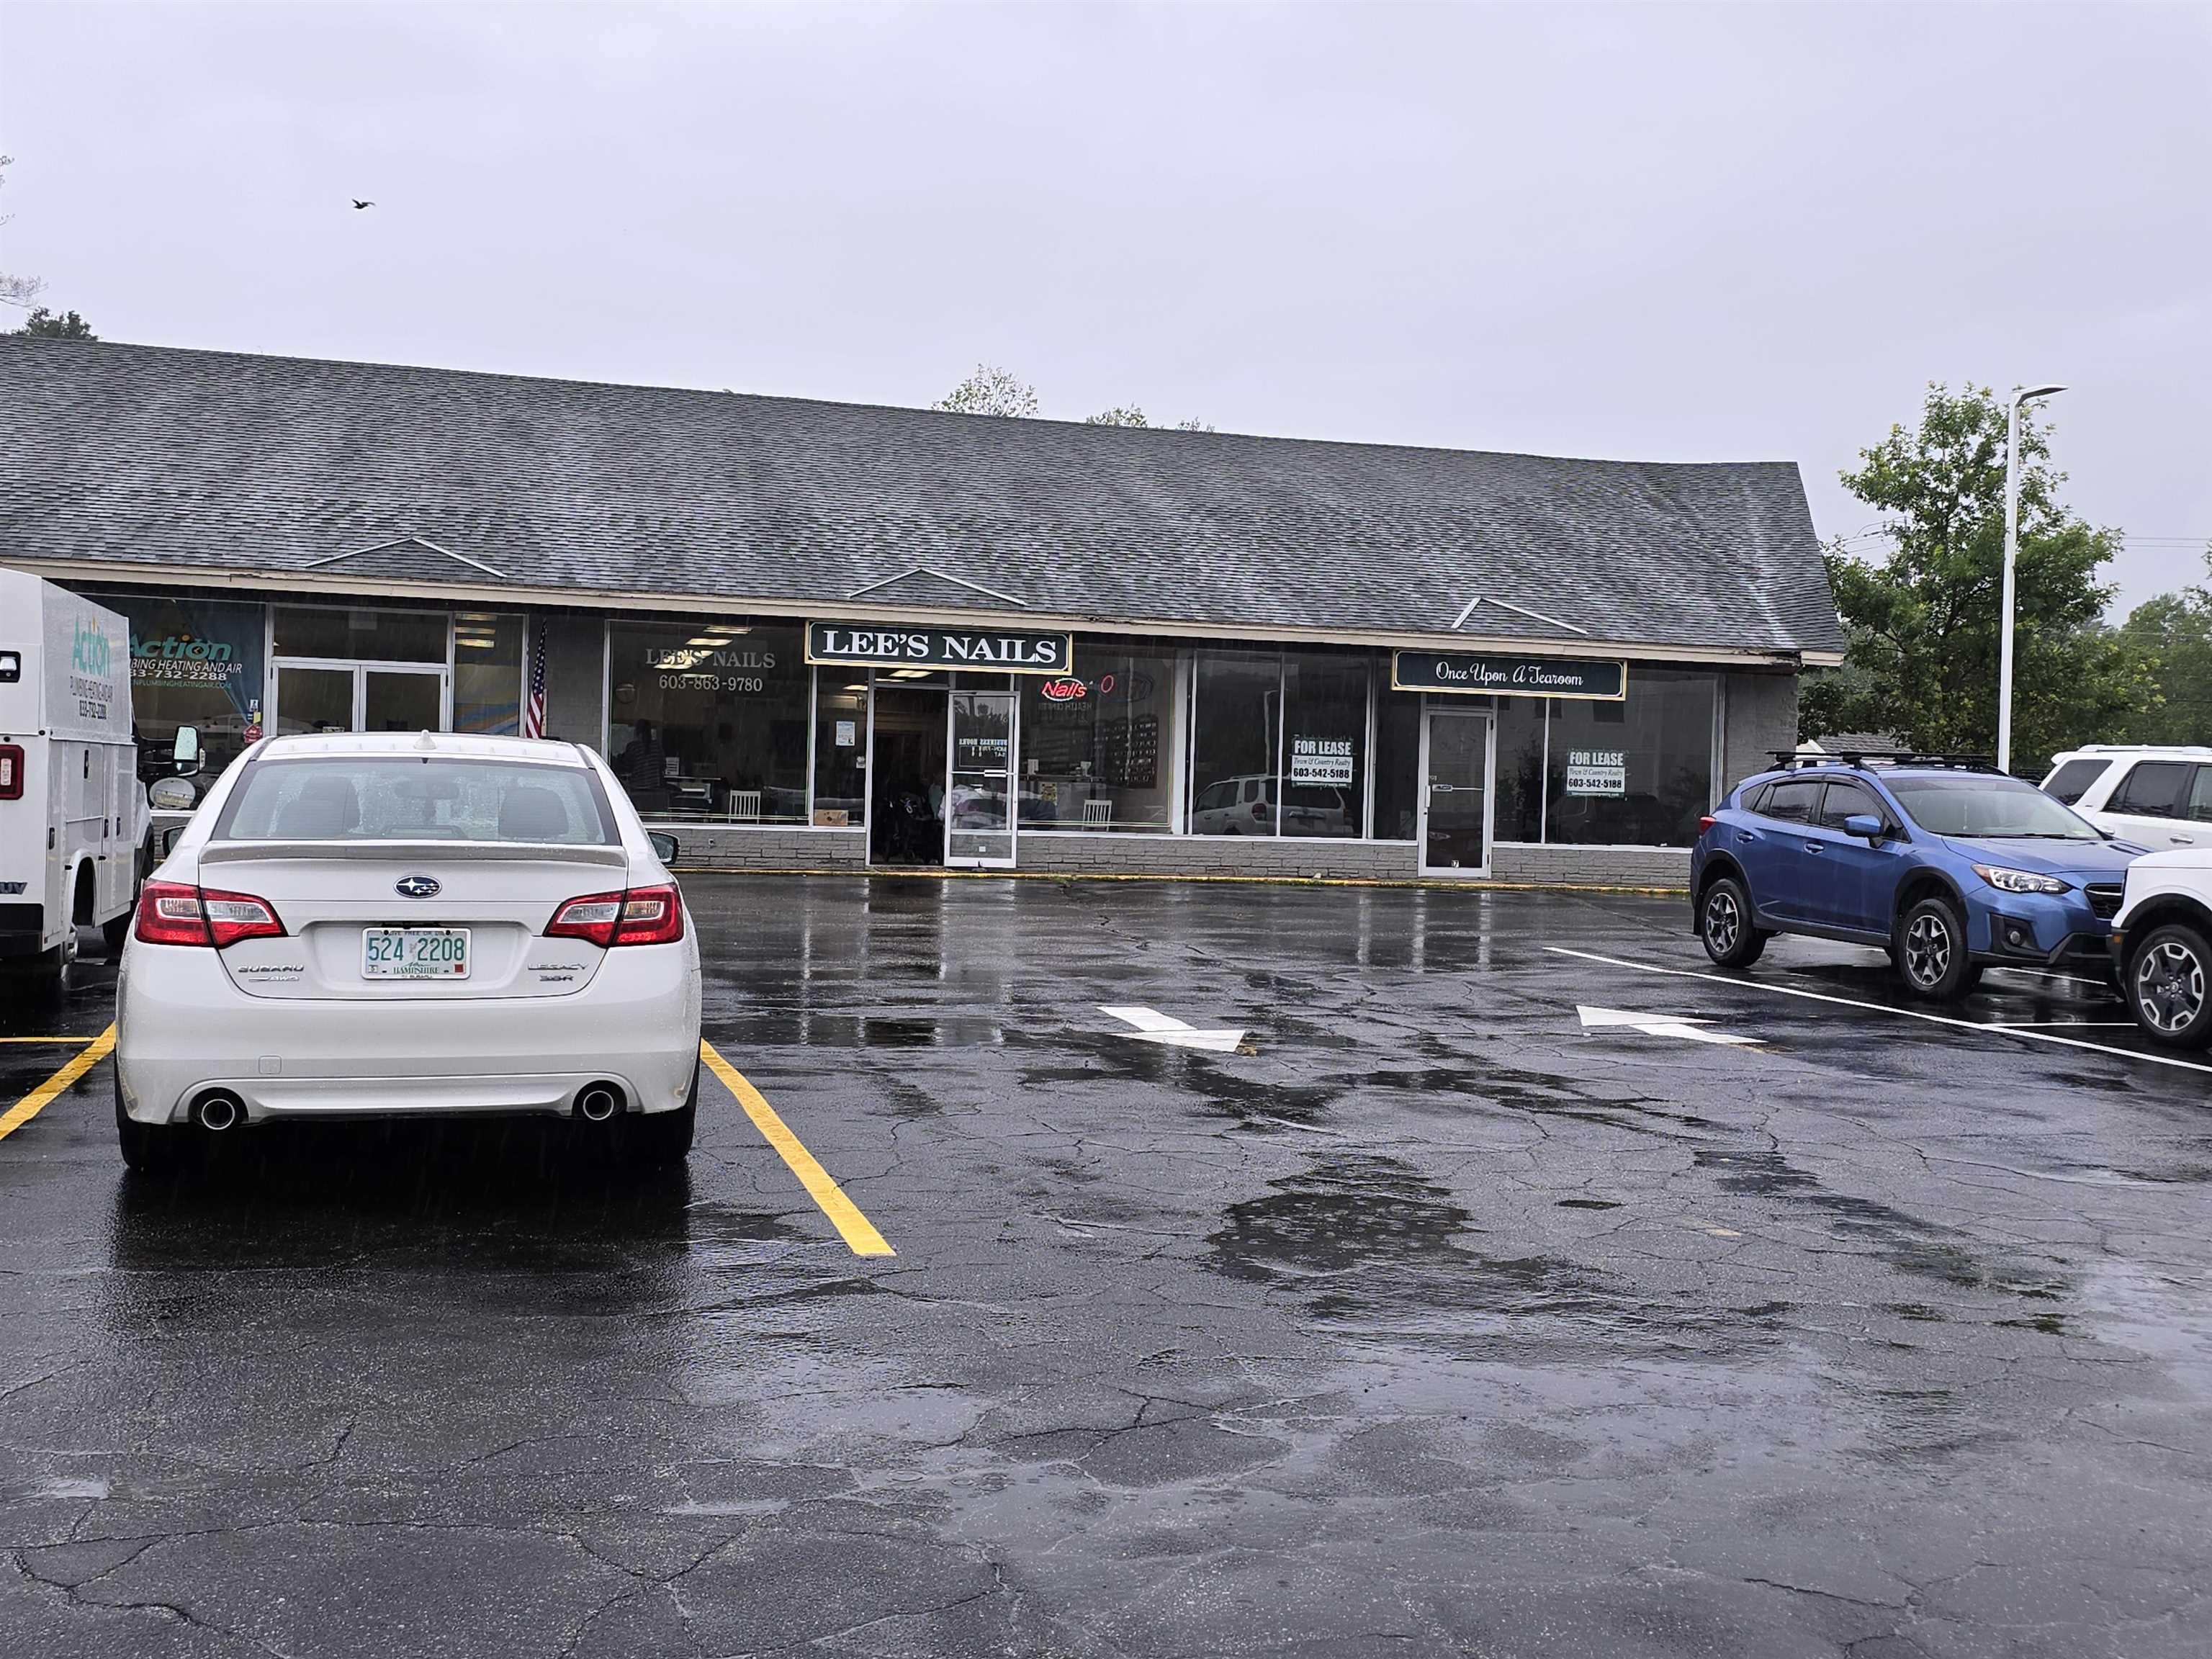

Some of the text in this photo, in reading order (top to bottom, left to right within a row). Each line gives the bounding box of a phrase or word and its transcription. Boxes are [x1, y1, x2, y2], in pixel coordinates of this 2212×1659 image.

[72, 614, 110, 679] Action
[129, 634, 232, 660] Action
[822, 630, 1057, 663] LEE'S NAILS
[130, 658, 243, 674] BING HEATING AND AIR
[713, 651, 775, 668] NAILS
[129, 669, 228, 681] 33-732-2288
[1436, 661, 1583, 685] Once Upon A Tearoom
[659, 675, 763, 691] 603-863-9780
[1041, 681, 1087, 698] Nails
[1294, 740, 1351, 755] FOR LEASE
[1570, 751, 1624, 766] FOR LEASE
[1293, 768, 1349, 778] 603-542-5188
[1568, 778, 1622, 788] 603-542-5188
[368, 938, 465, 961] 524 2208
[238, 964, 304, 973] SUBARU
